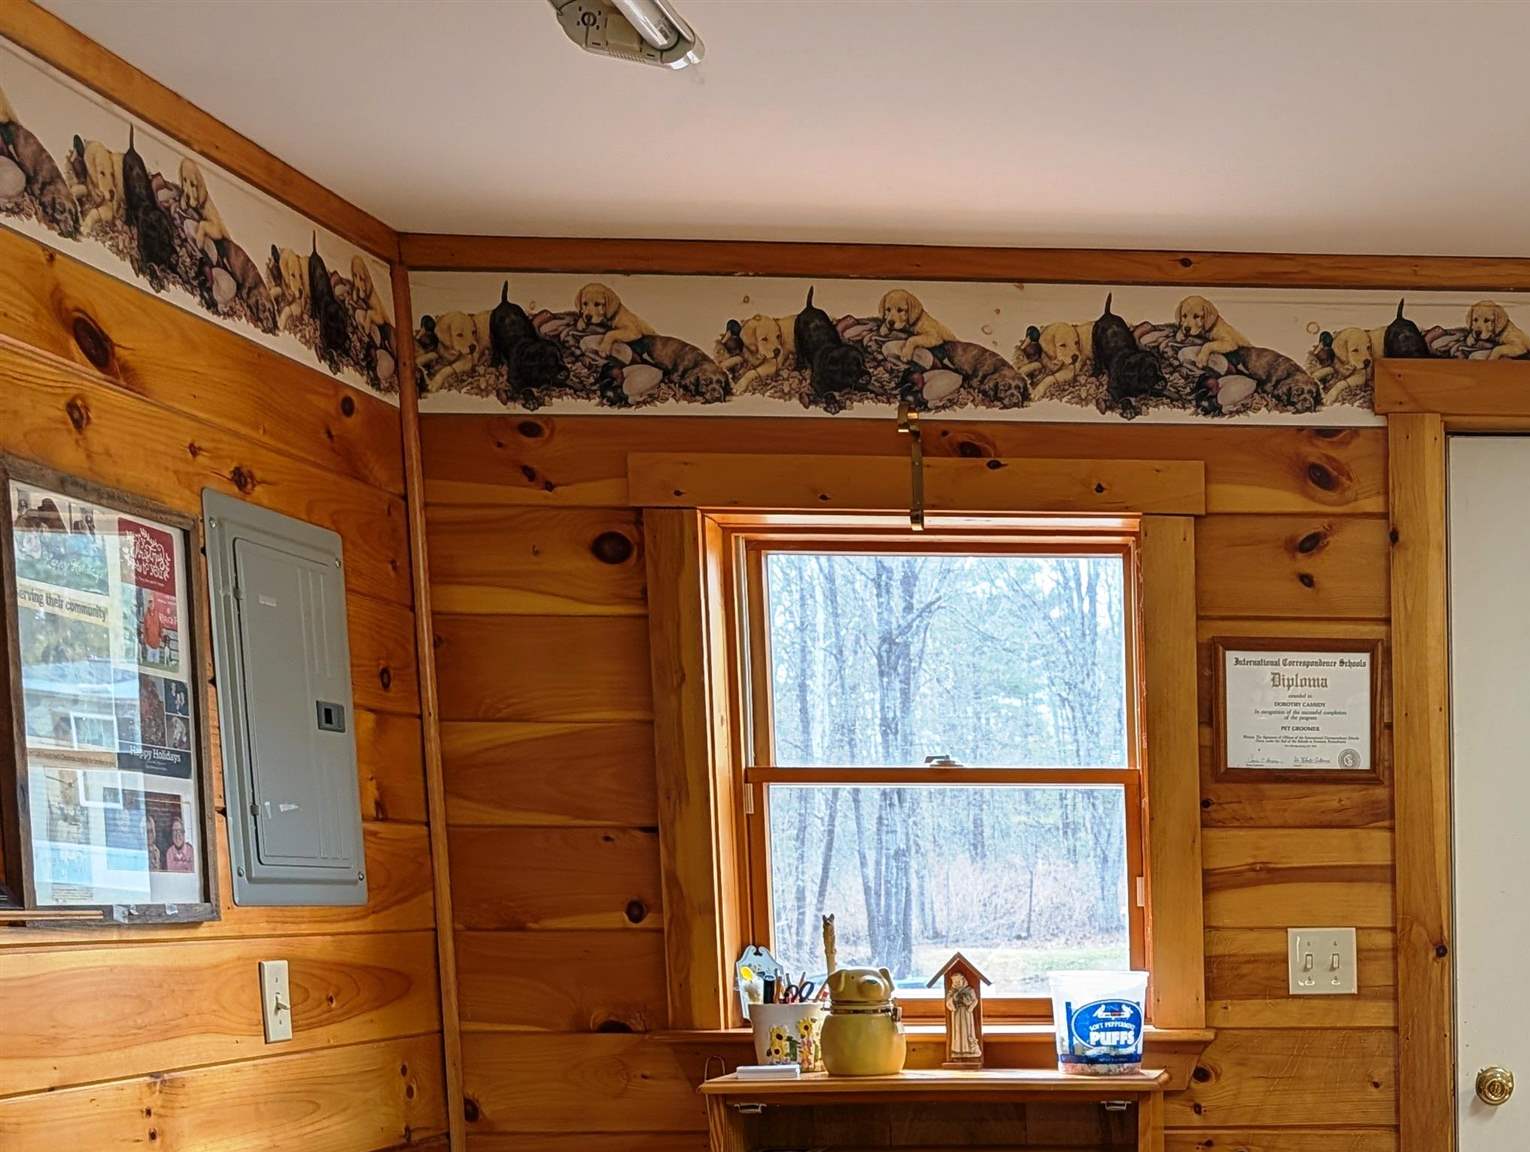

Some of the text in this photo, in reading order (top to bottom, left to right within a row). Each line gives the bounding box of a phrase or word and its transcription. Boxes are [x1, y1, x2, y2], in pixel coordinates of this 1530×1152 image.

[1234, 657, 1367, 669] International Correspondence Schools
[1271, 671, 1328, 691] Diploma
[152, 748, 181, 763] Holidays
[1089, 1031, 1135, 1046] PUFFS
